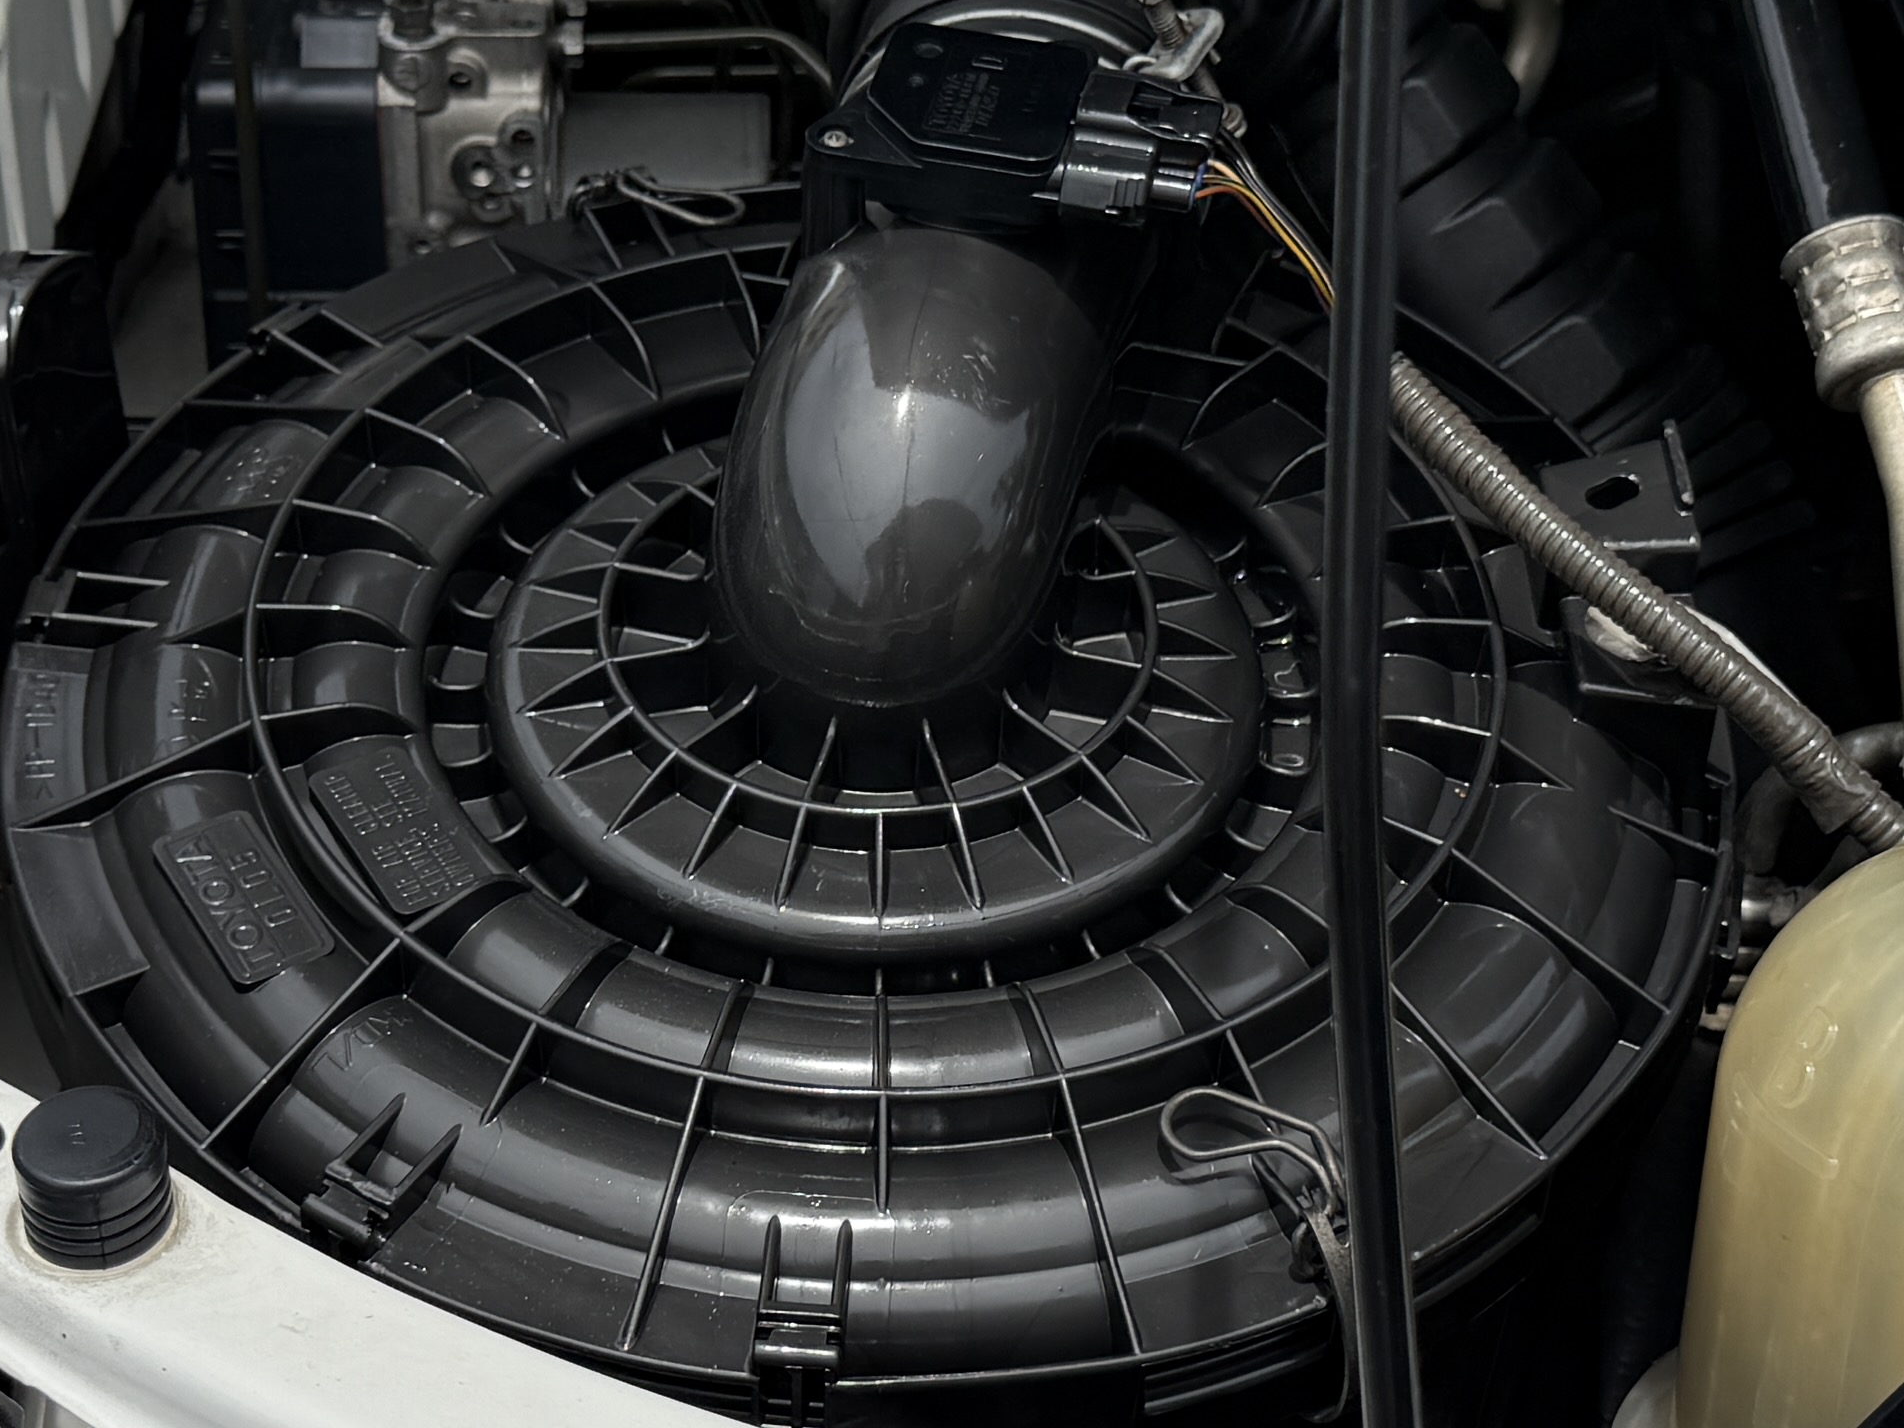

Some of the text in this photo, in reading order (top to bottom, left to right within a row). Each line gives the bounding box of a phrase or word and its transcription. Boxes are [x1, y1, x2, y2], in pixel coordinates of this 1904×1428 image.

[323, 772, 429, 906] FOR AIR CLEANER
[372, 799, 405, 828] SEE
[172, 834, 276, 968] TOYOTA
